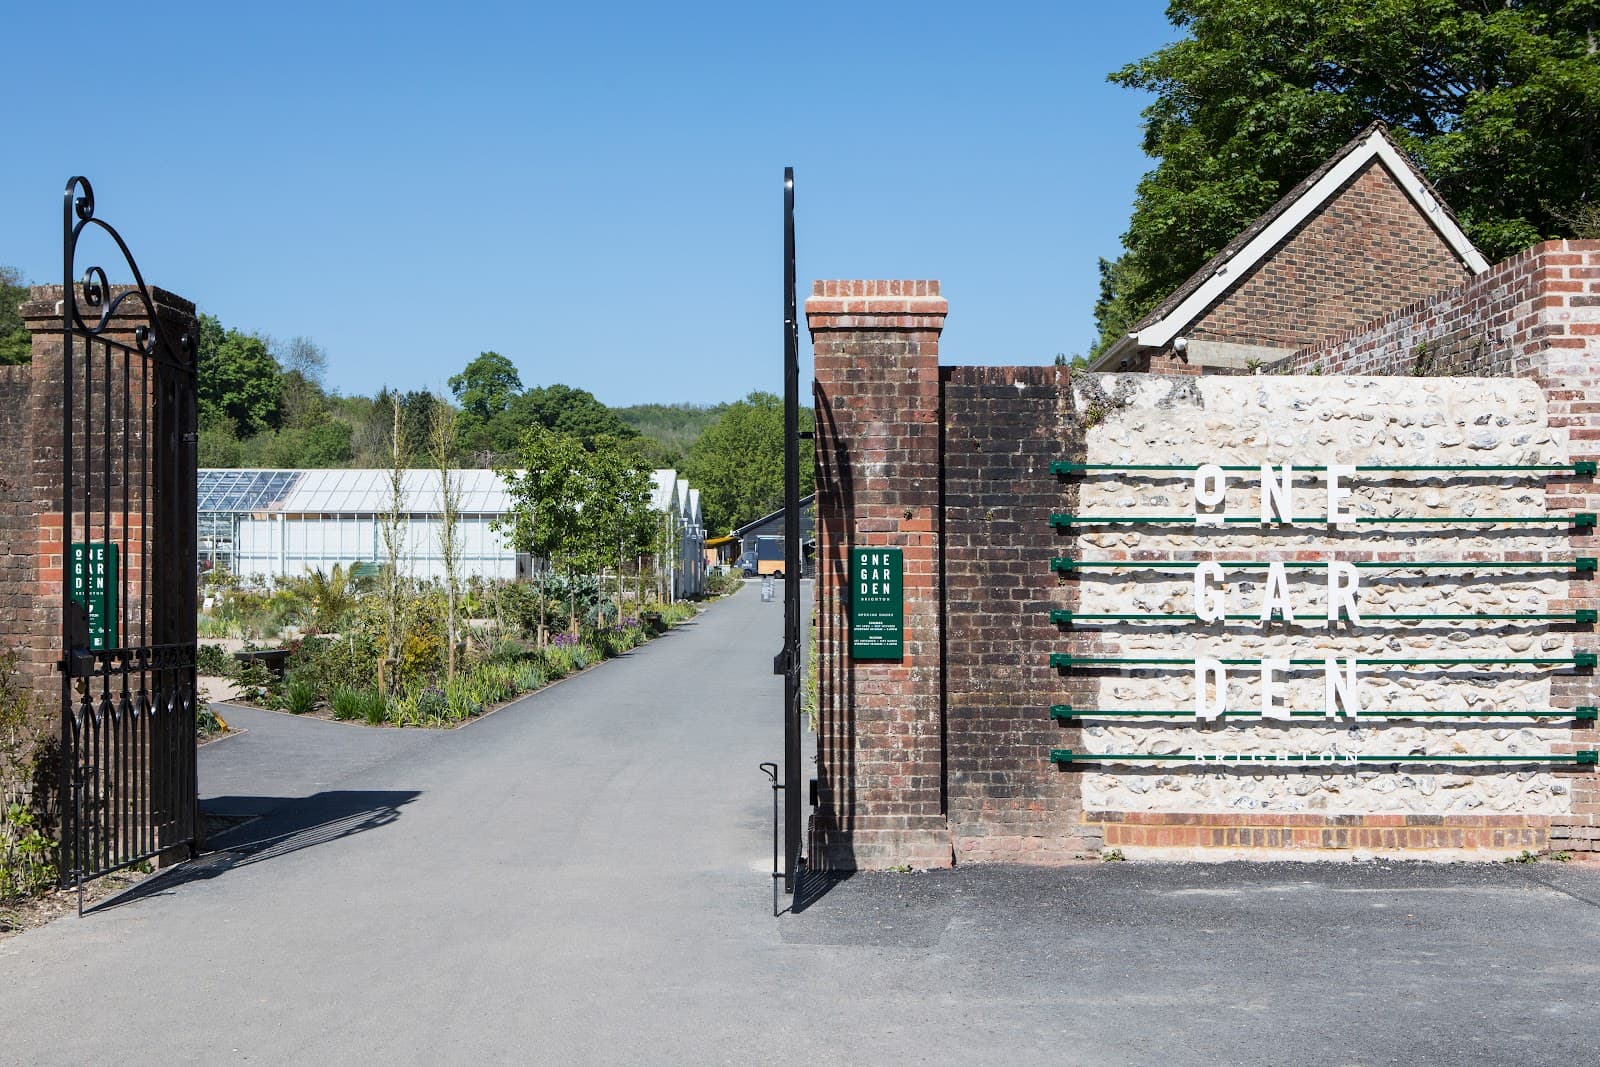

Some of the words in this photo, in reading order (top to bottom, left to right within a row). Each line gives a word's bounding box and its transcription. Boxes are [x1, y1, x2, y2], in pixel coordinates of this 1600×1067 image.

[1194, 464, 1357, 524] ONE
[860, 554, 890, 566] ONE
[861, 569, 890, 580] GAR
[861, 583, 890, 594] DEN
[1194, 561, 1361, 621] GAR
[1195, 658, 1357, 718] DEN
[1195, 750, 1358, 766] BRIGHTON
